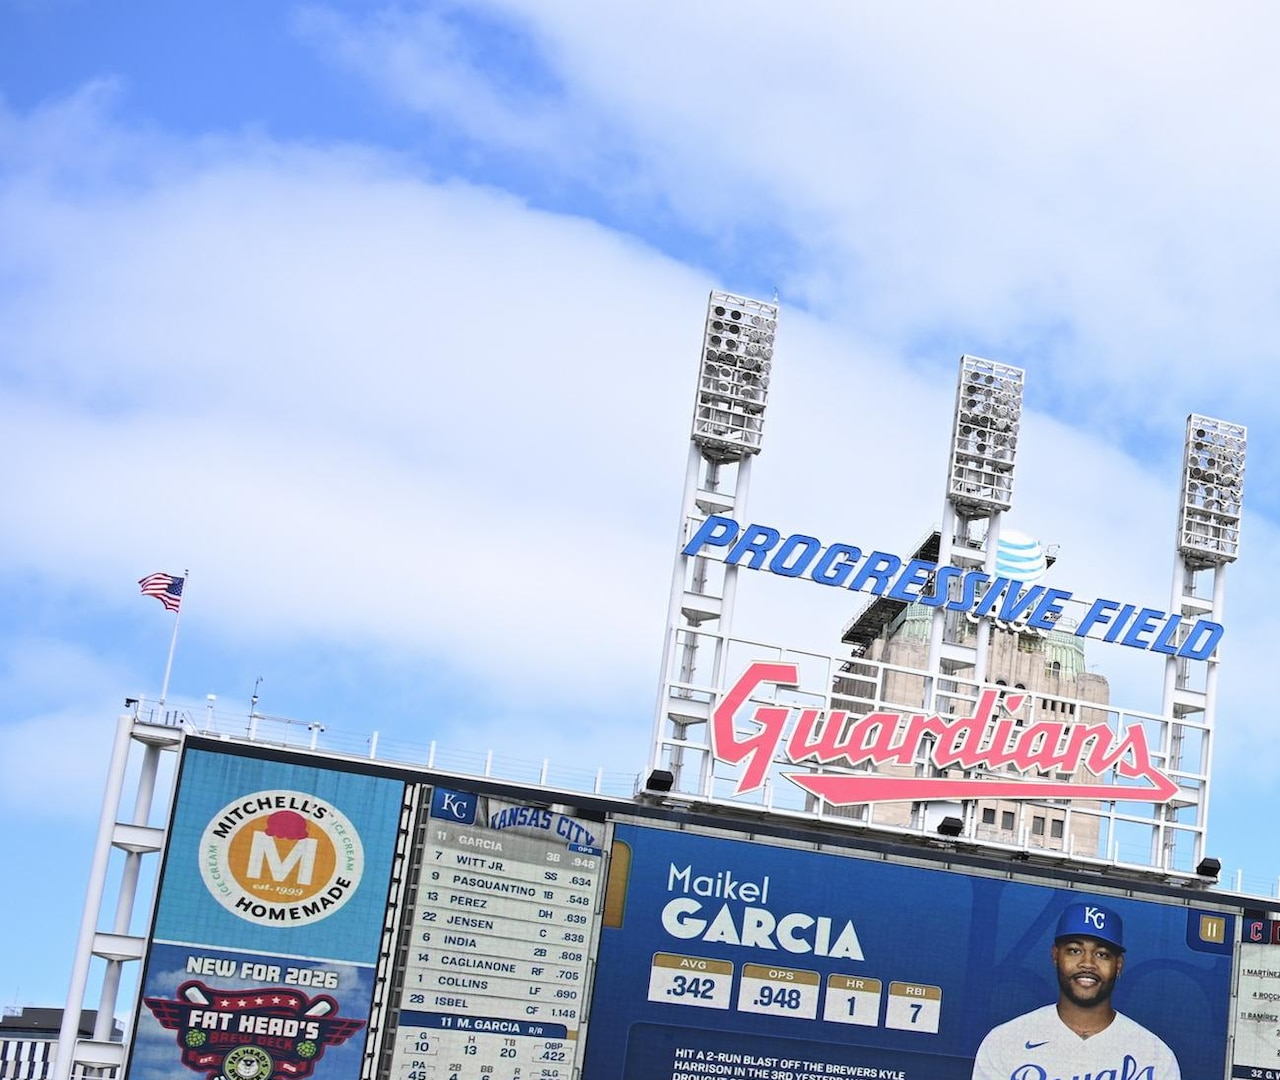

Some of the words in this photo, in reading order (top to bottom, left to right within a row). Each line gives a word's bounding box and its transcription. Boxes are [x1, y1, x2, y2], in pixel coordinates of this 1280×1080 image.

[682, 515, 1073, 630] PROGRESSIVE
[1075, 598, 1224, 661] FIELD
[712, 659, 1181, 807] Guardians
[213, 796, 327, 838] MITCHELL'S
[490, 807, 552, 830] KANSAS
[556, 815, 595, 845] CITY
[246, 830, 318, 886] M
[457, 855, 485, 868] WITT
[488, 861, 505, 871] JR.
[235, 877, 351, 920] HOMEMADE
[453, 875, 536, 897] PASQUANTINO
[667, 862, 769, 904] Maikel
[450, 896, 487, 909] PEREZ
[447, 915, 493, 930] JENSEN
[661, 897, 865, 961] GARCIA
[444, 935, 476, 948] INDIA
[186, 956, 236, 977] NEW
[241, 963, 281, 983] FOR
[285, 968, 339, 989] 2026
[441, 956, 516, 973] CAGLIANONE
[680, 958, 707, 970] AVG
[769, 970, 794, 980] OPS
[846, 979, 864, 989] HR
[906, 986, 926, 997] RBI
[438, 976, 488, 990] COLLINS
[435, 996, 468, 1008] ISBEL
[666, 976, 715, 1000] .342
[753, 986, 801, 1009] .948
[847, 997, 856, 1016] 1
[910, 1004, 922, 1023] 7
[189, 1010, 233, 1031] FAT
[239, 1015, 320, 1040] HEAD'S
[210, 1032, 253, 1044] BREW
[257, 1036, 293, 1050] DECK
[675, 1049, 695, 1059] HIT
[696, 1051, 704, 1060] A
[706, 1051, 741, 1064] 2-RUN
[744, 1055, 779, 1068] BLAST
[780, 1060, 801, 1069] OFF
[803, 1061, 823, 1072] THE
[826, 1064, 877, 1078] BREWERS
[879, 1070, 905, 1080] KYLE
[1251, 1070, 1262, 1078] 32
[1266, 1071, 1274, 1079] G.
